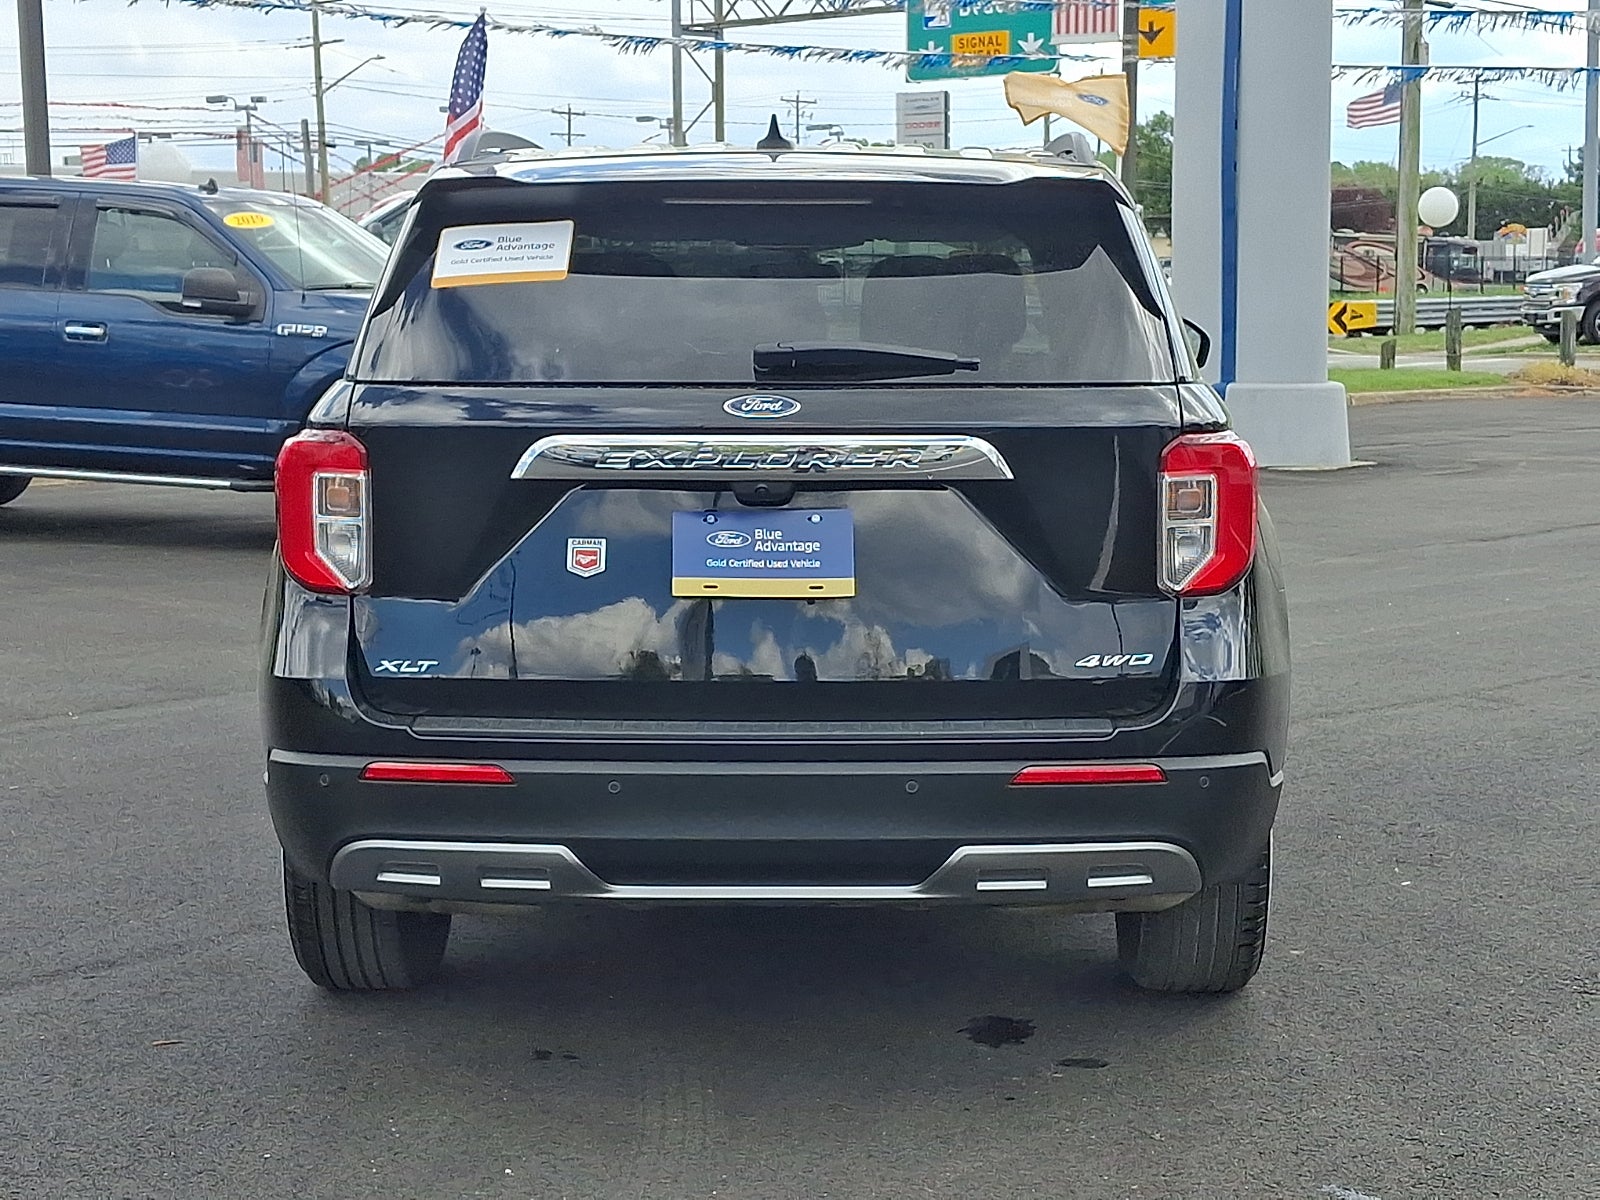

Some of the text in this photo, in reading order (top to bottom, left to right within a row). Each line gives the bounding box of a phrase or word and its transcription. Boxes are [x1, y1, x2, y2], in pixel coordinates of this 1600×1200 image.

[958, 35, 1003, 49] SIGNAL
[233, 214, 264, 225] 2019
[497, 235, 522, 243] Blue
[496, 242, 556, 251] Advantage
[470, 256, 503, 264] Certified
[741, 397, 784, 411] Ford
[595, 448, 924, 469] EXPLORER
[714, 533, 743, 545] Ford
[754, 528, 783, 540] Blue
[754, 540, 821, 553] Advantage
[706, 558, 821, 568] Gold Certified Used Vehicle
[374, 660, 439, 673] XLT
[1074, 653, 1154, 668] 4WD
